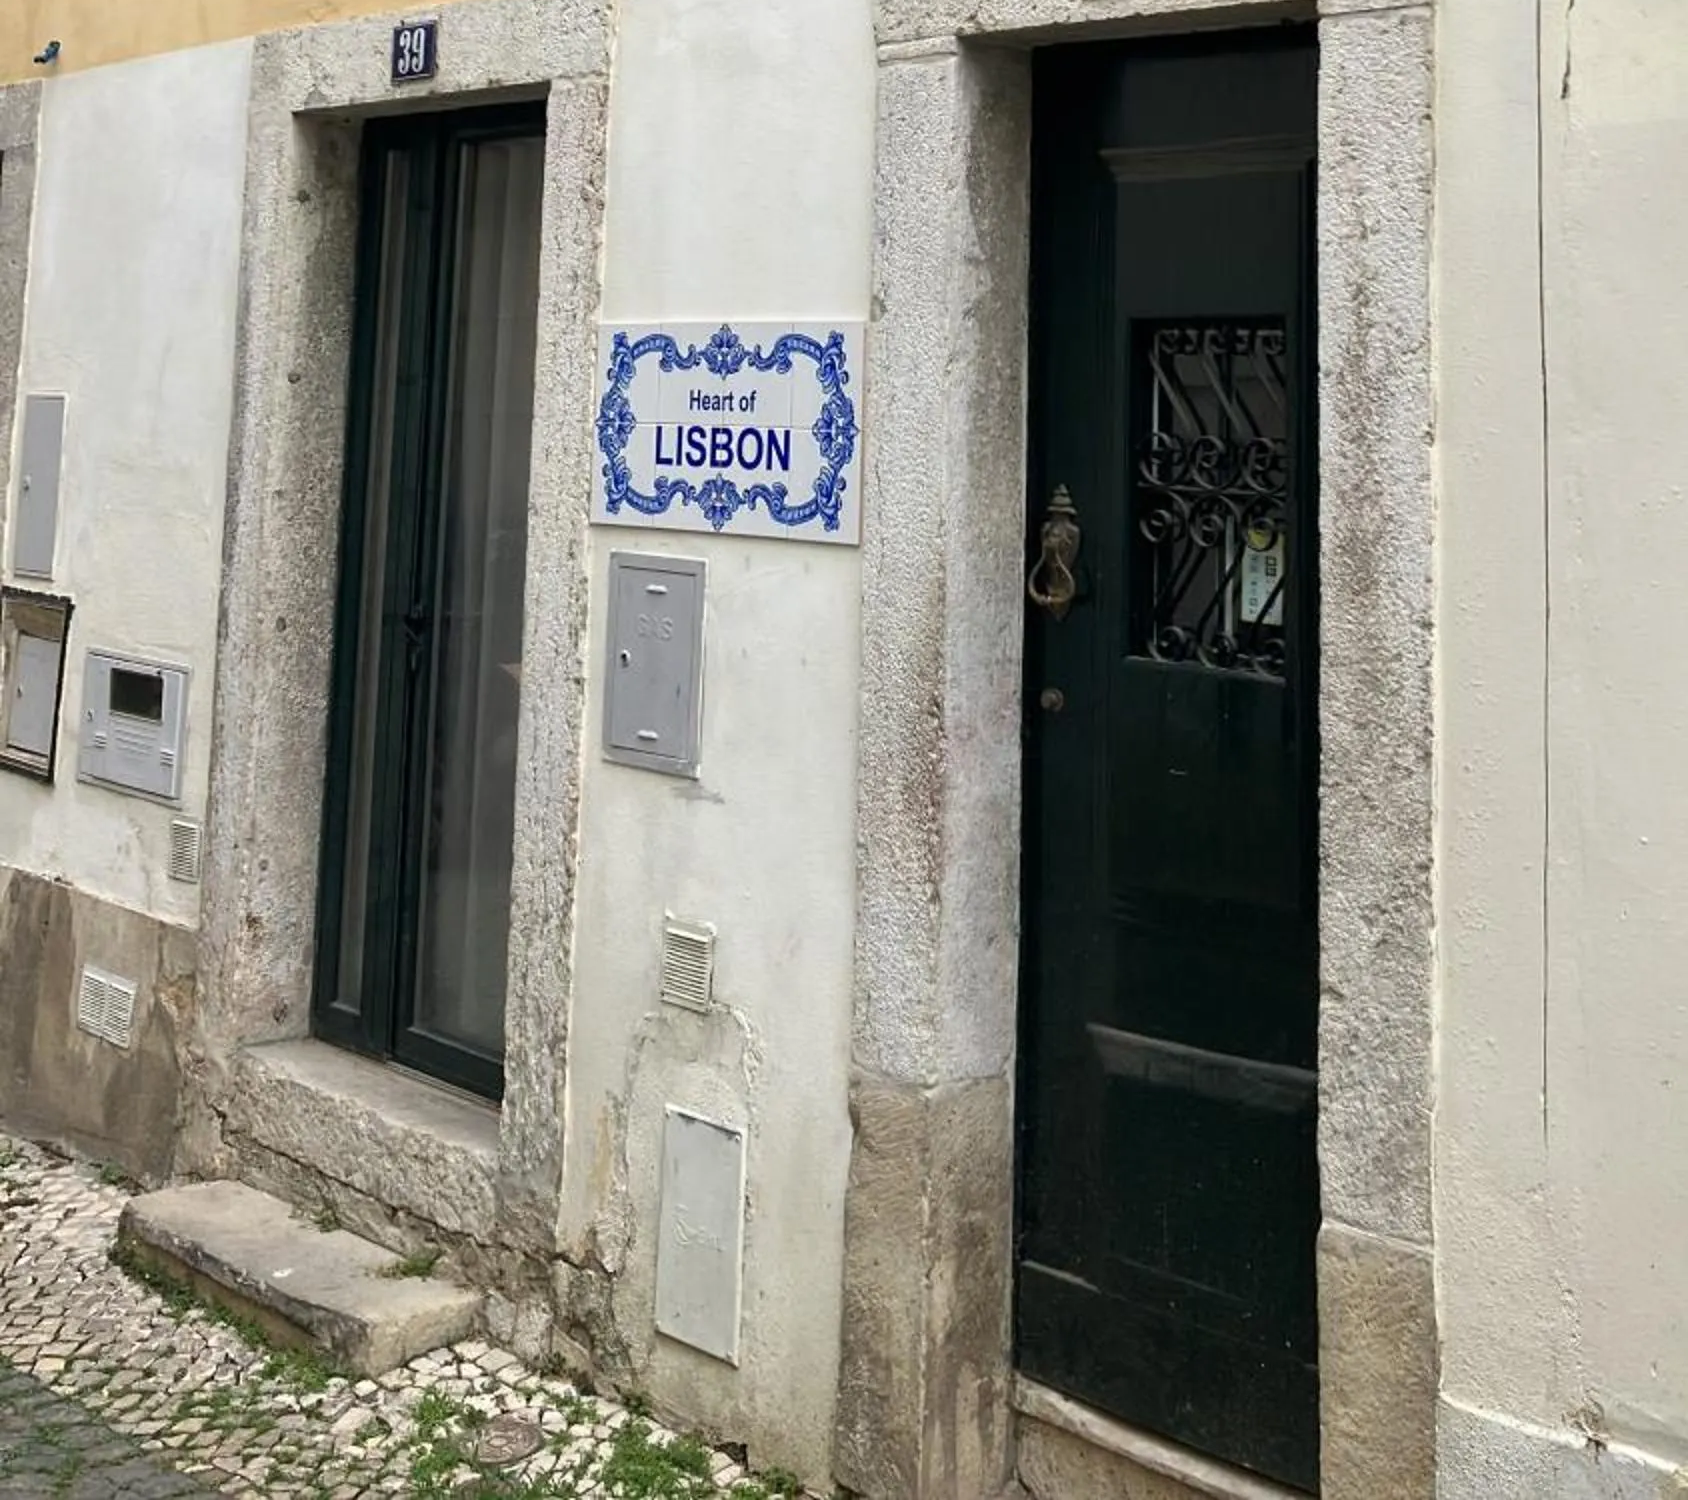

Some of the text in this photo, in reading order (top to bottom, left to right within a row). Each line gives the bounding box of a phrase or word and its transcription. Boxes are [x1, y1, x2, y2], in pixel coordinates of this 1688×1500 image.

[398, 28, 425, 74] 39
[689, 389, 756, 412] Heart of
[655, 425, 790, 471] LISBON
